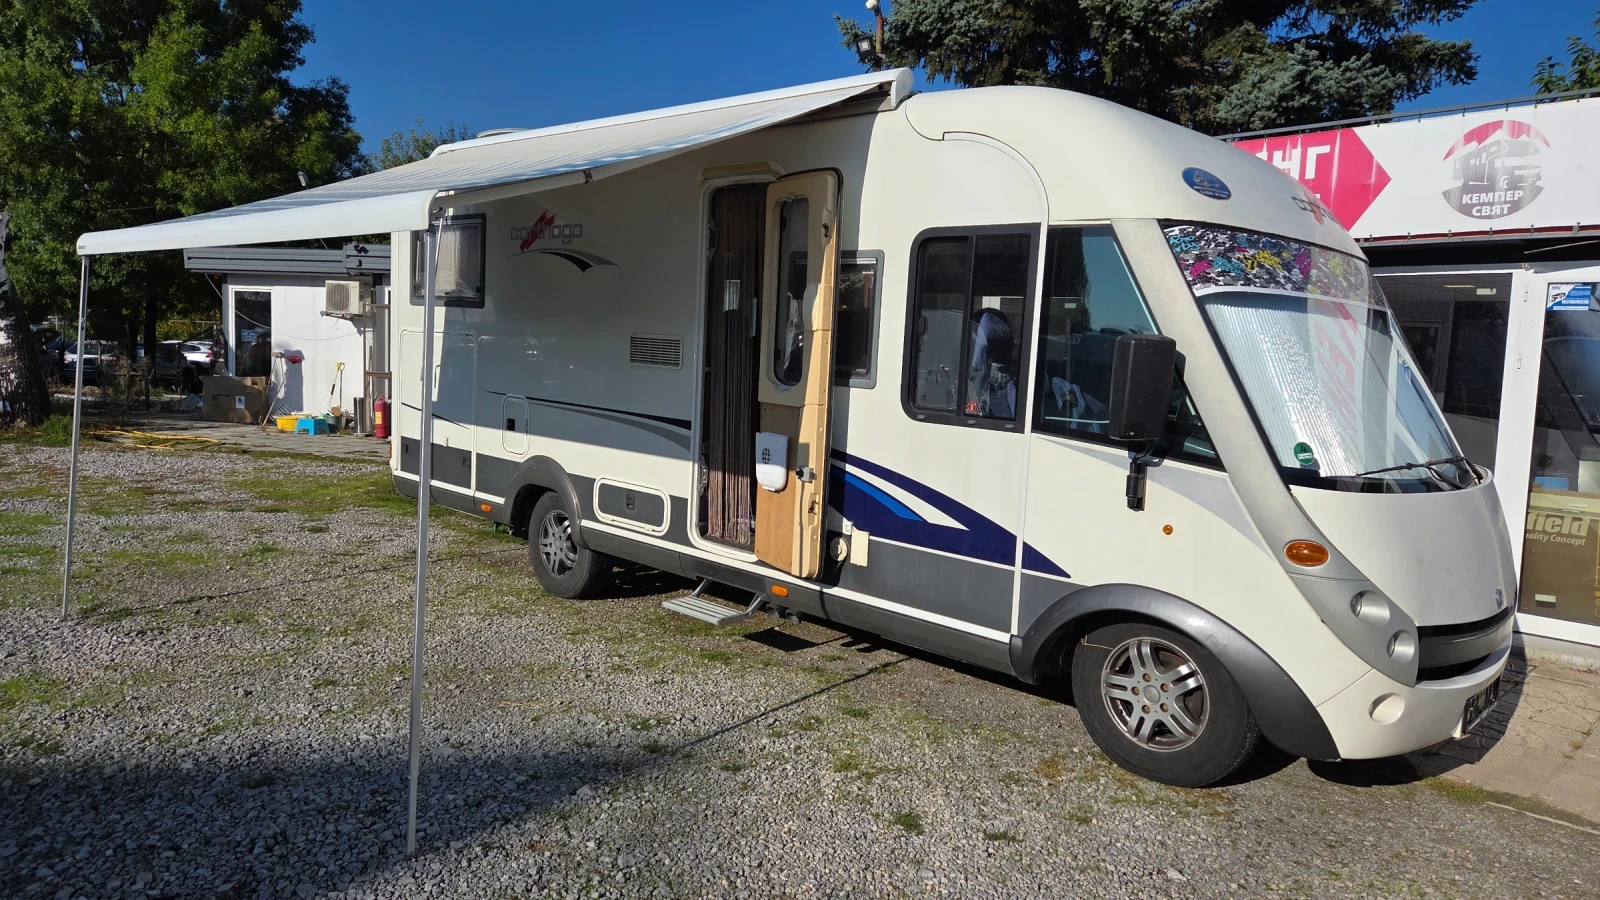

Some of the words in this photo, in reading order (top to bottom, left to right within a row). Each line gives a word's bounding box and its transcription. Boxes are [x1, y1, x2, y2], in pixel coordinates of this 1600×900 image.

[1462, 190, 1524, 204] КЕМПЕР
[1472, 204, 1511, 216] СВЯТ
[1550, 534, 1586, 546] Concept
